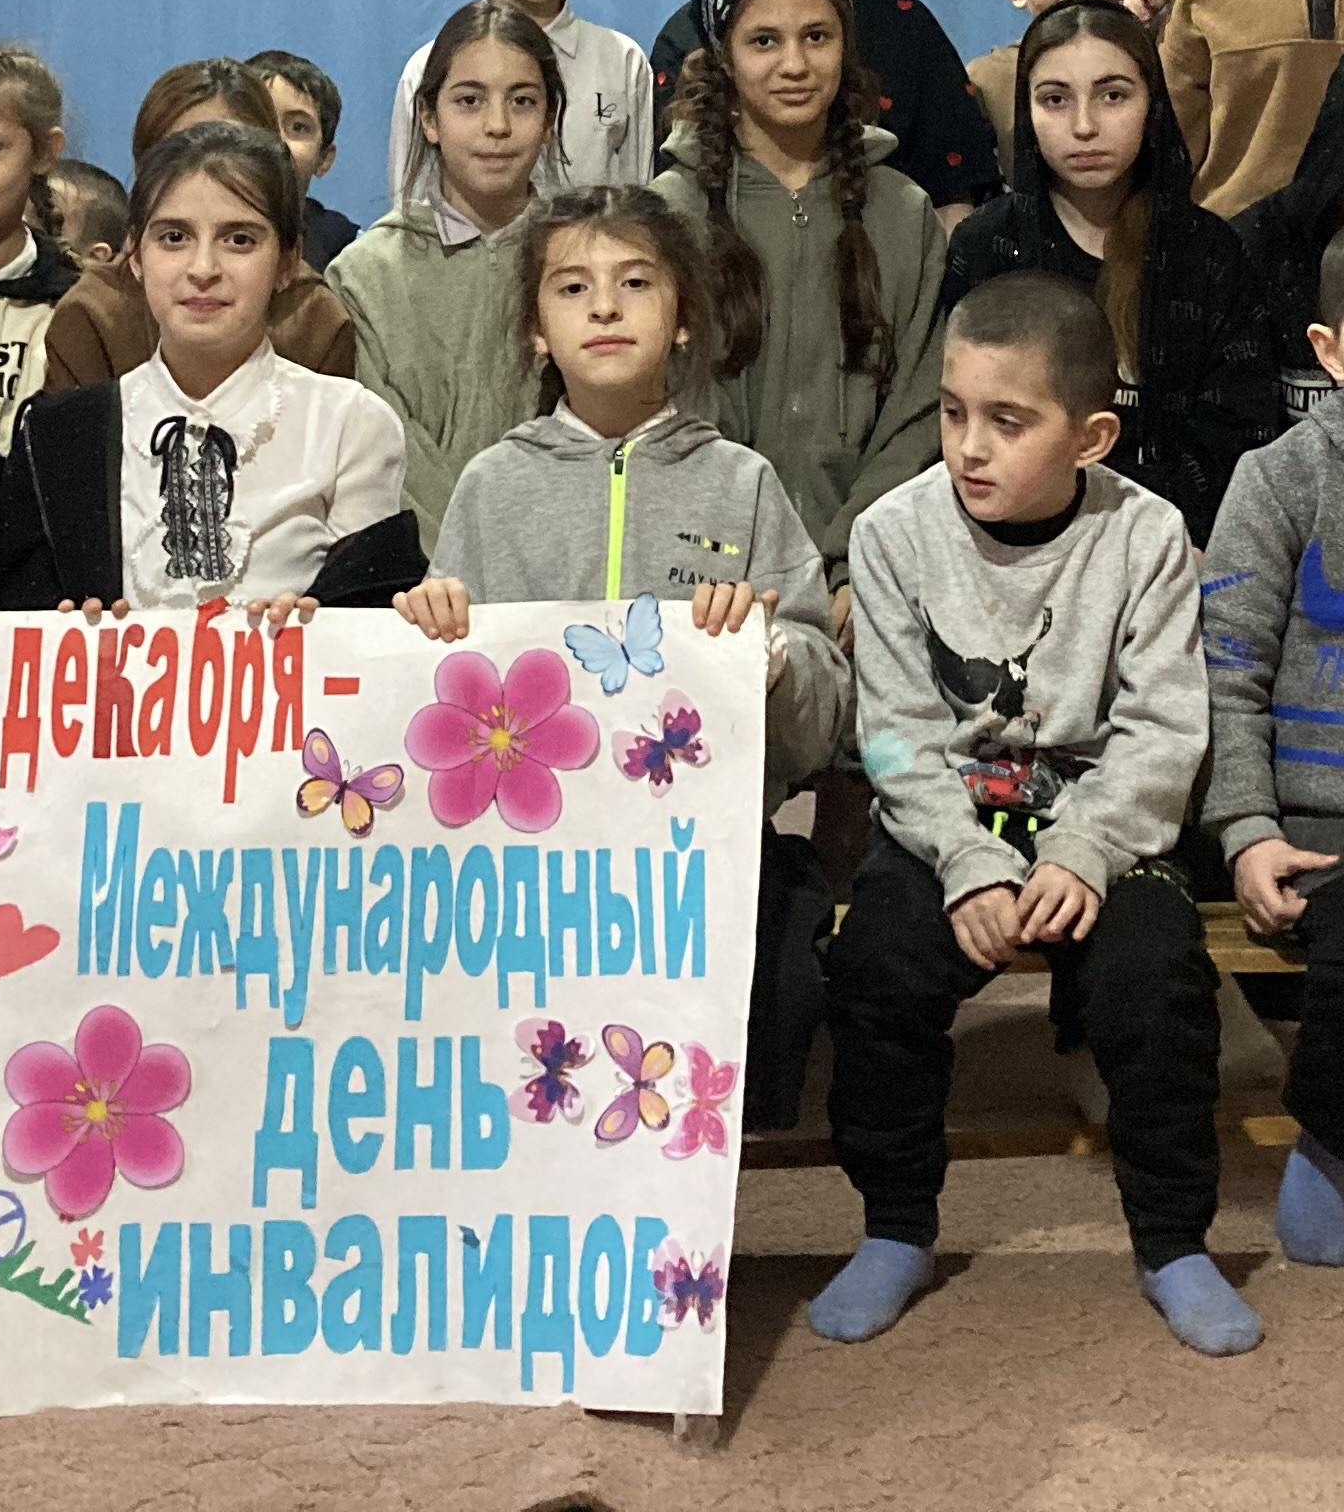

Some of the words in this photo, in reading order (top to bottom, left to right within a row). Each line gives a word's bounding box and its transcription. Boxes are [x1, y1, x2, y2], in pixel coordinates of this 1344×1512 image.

[77, 801, 706, 1026] Международный
[252, 1036, 509, 1208] день
[117, 1213, 668, 1394] инвалидов
